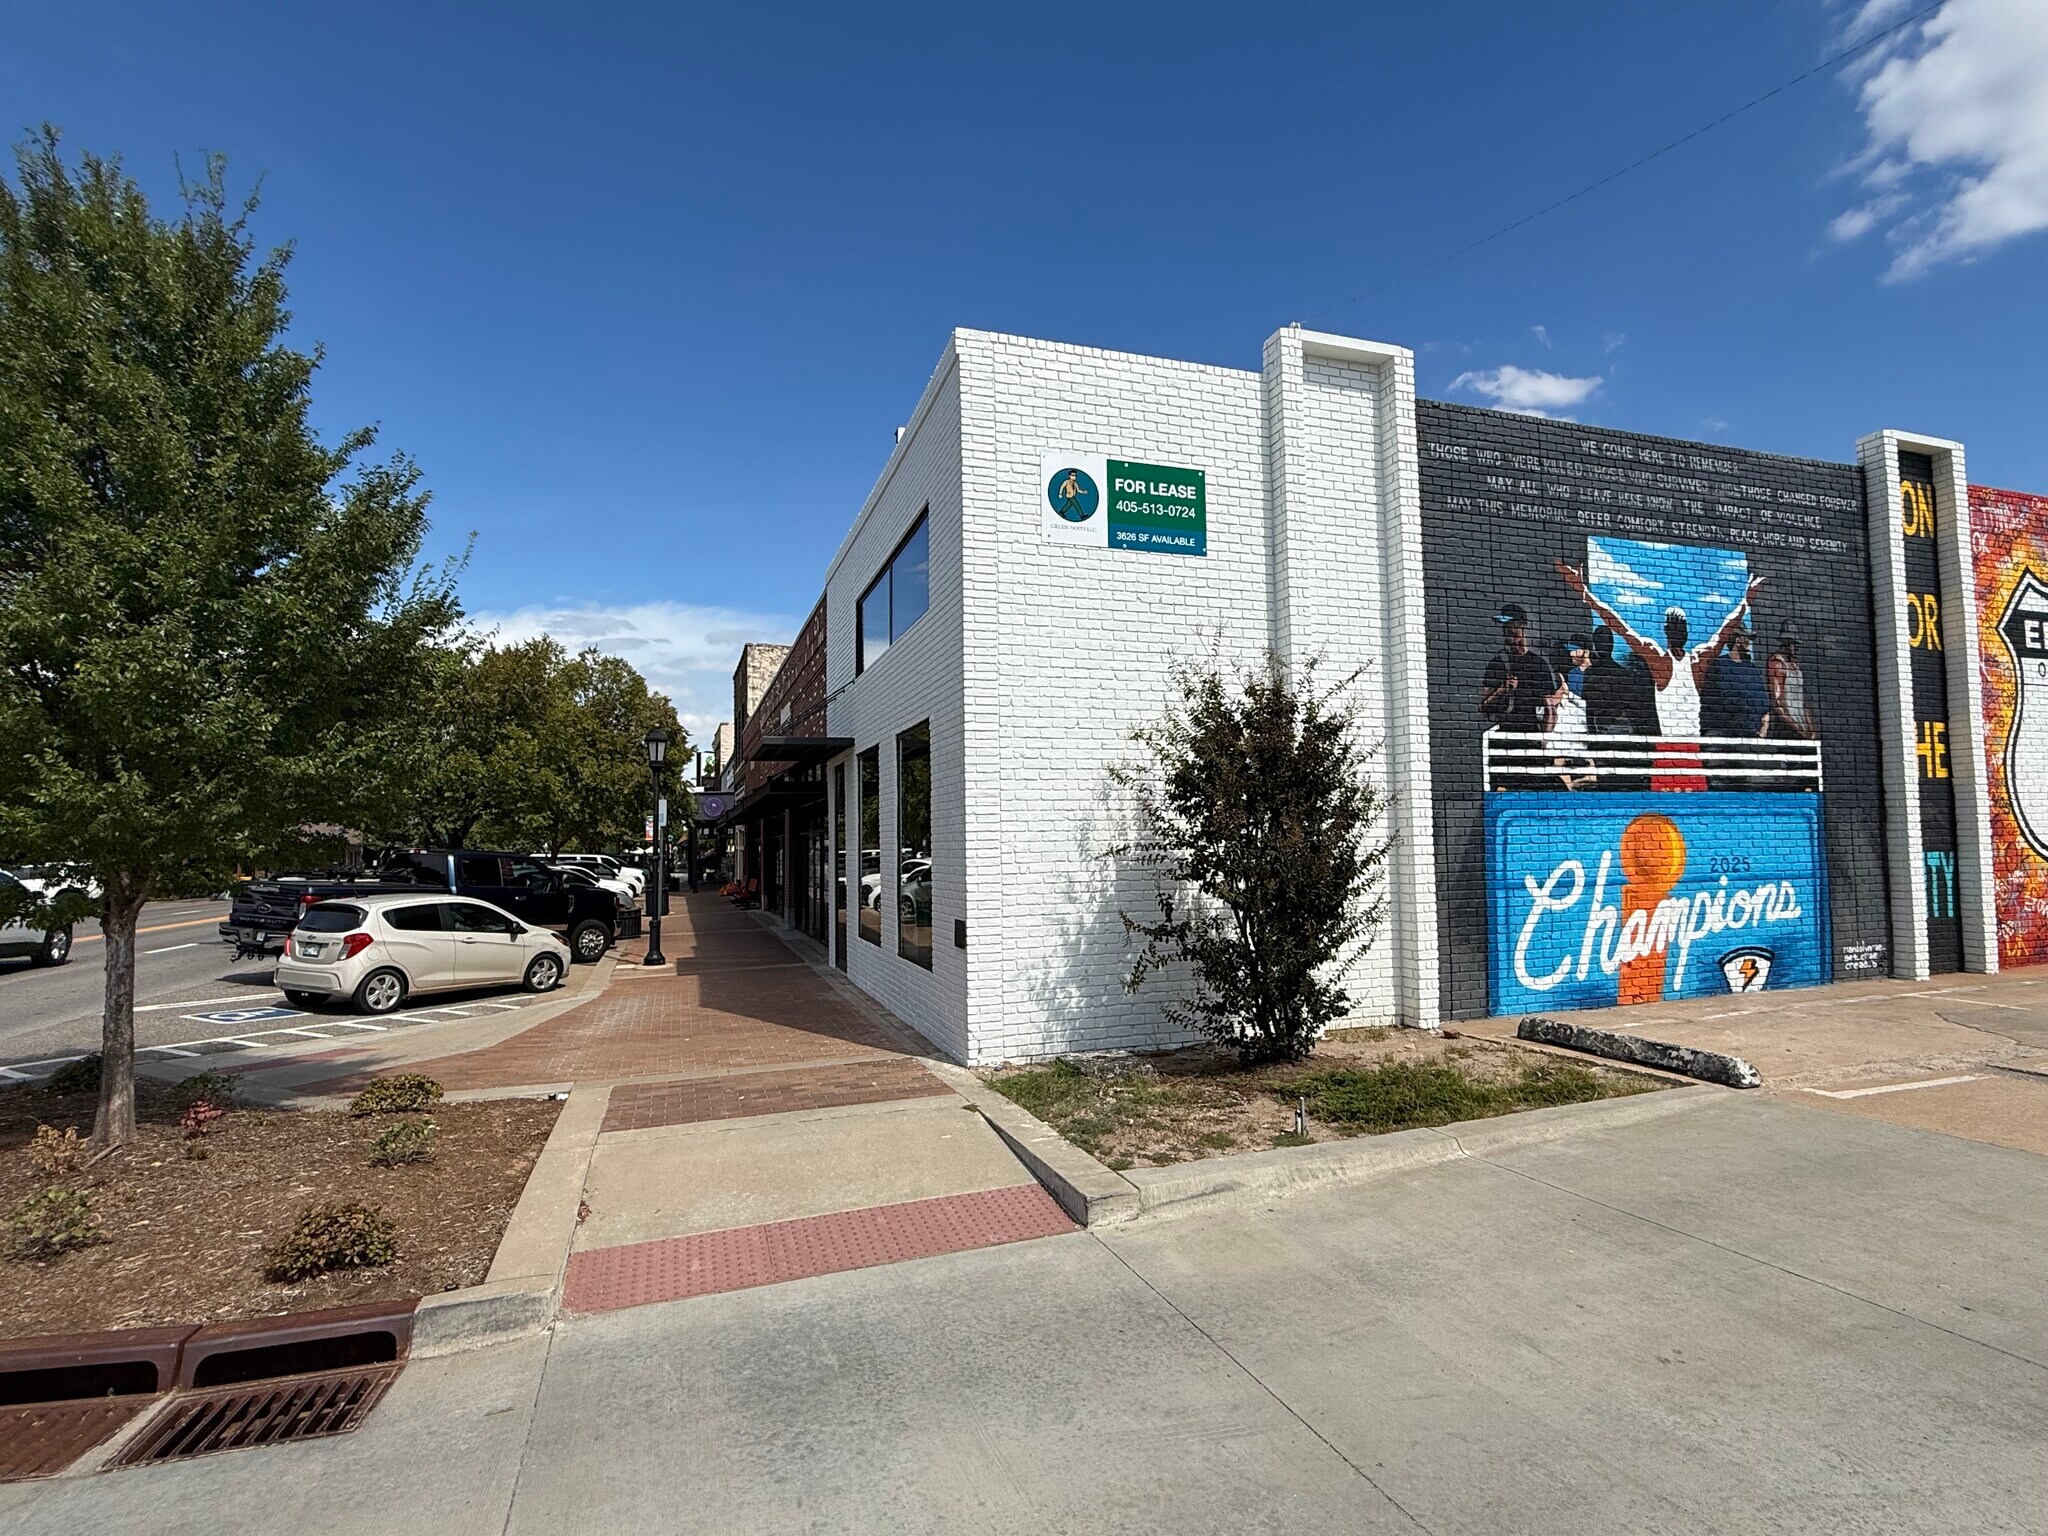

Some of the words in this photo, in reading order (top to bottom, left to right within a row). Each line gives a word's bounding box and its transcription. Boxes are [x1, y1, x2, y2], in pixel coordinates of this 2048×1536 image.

[1428, 442, 1468, 460] THOSE
[1476, 449, 1502, 466] WHO
[1510, 454, 1540, 471] WERE
[1656, 473, 1708, 492] SURVIVED
[1740, 485, 1772, 501] THOSE
[1778, 490, 1816, 506] CHANGED
[1820, 495, 1857, 512] FOREVER
[1580, 439, 1598, 454] WE
[1602, 442, 1633, 458] COME
[1639, 447, 1665, 464] HERE
[1670, 453, 1685, 467] TO
[1690, 456, 1739, 474] REMEMBER
[1115, 478, 1146, 494] FOR
[1150, 482, 1196, 500] LEASE
[1116, 500, 1196, 518] 405-513-0724
[1487, 475, 1514, 490] MAY
[1520, 480, 1539, 494] ALL
[1547, 483, 1570, 498] WHO
[1580, 486, 1612, 503] LEAVE
[1618, 492, 1643, 507] HERE
[1648, 496, 1673, 511] KNOW
[1682, 500, 1704, 514] THE
[1716, 504, 1750, 519] IMPACT
[1760, 510, 1772, 522] OF
[1777, 512, 1822, 528] VIOLENCE
[1116, 531, 1136, 542] 3626
[1139, 533, 1150, 542] SF
[1151, 534, 1196, 547] AVAILABLE
[1447, 495, 1472, 510] MAY
[1476, 498, 1504, 514] THIS
[1511, 502, 1572, 522] MEMORIAL
[1578, 510, 1612, 527] OFFER
[1788, 536, 1806, 548] AND
[1810, 538, 1848, 553] SERENITY
[1710, 857, 1750, 874] 2025
[1922, 850, 1955, 918] TY
[1514, 849, 1802, 991] Champions
